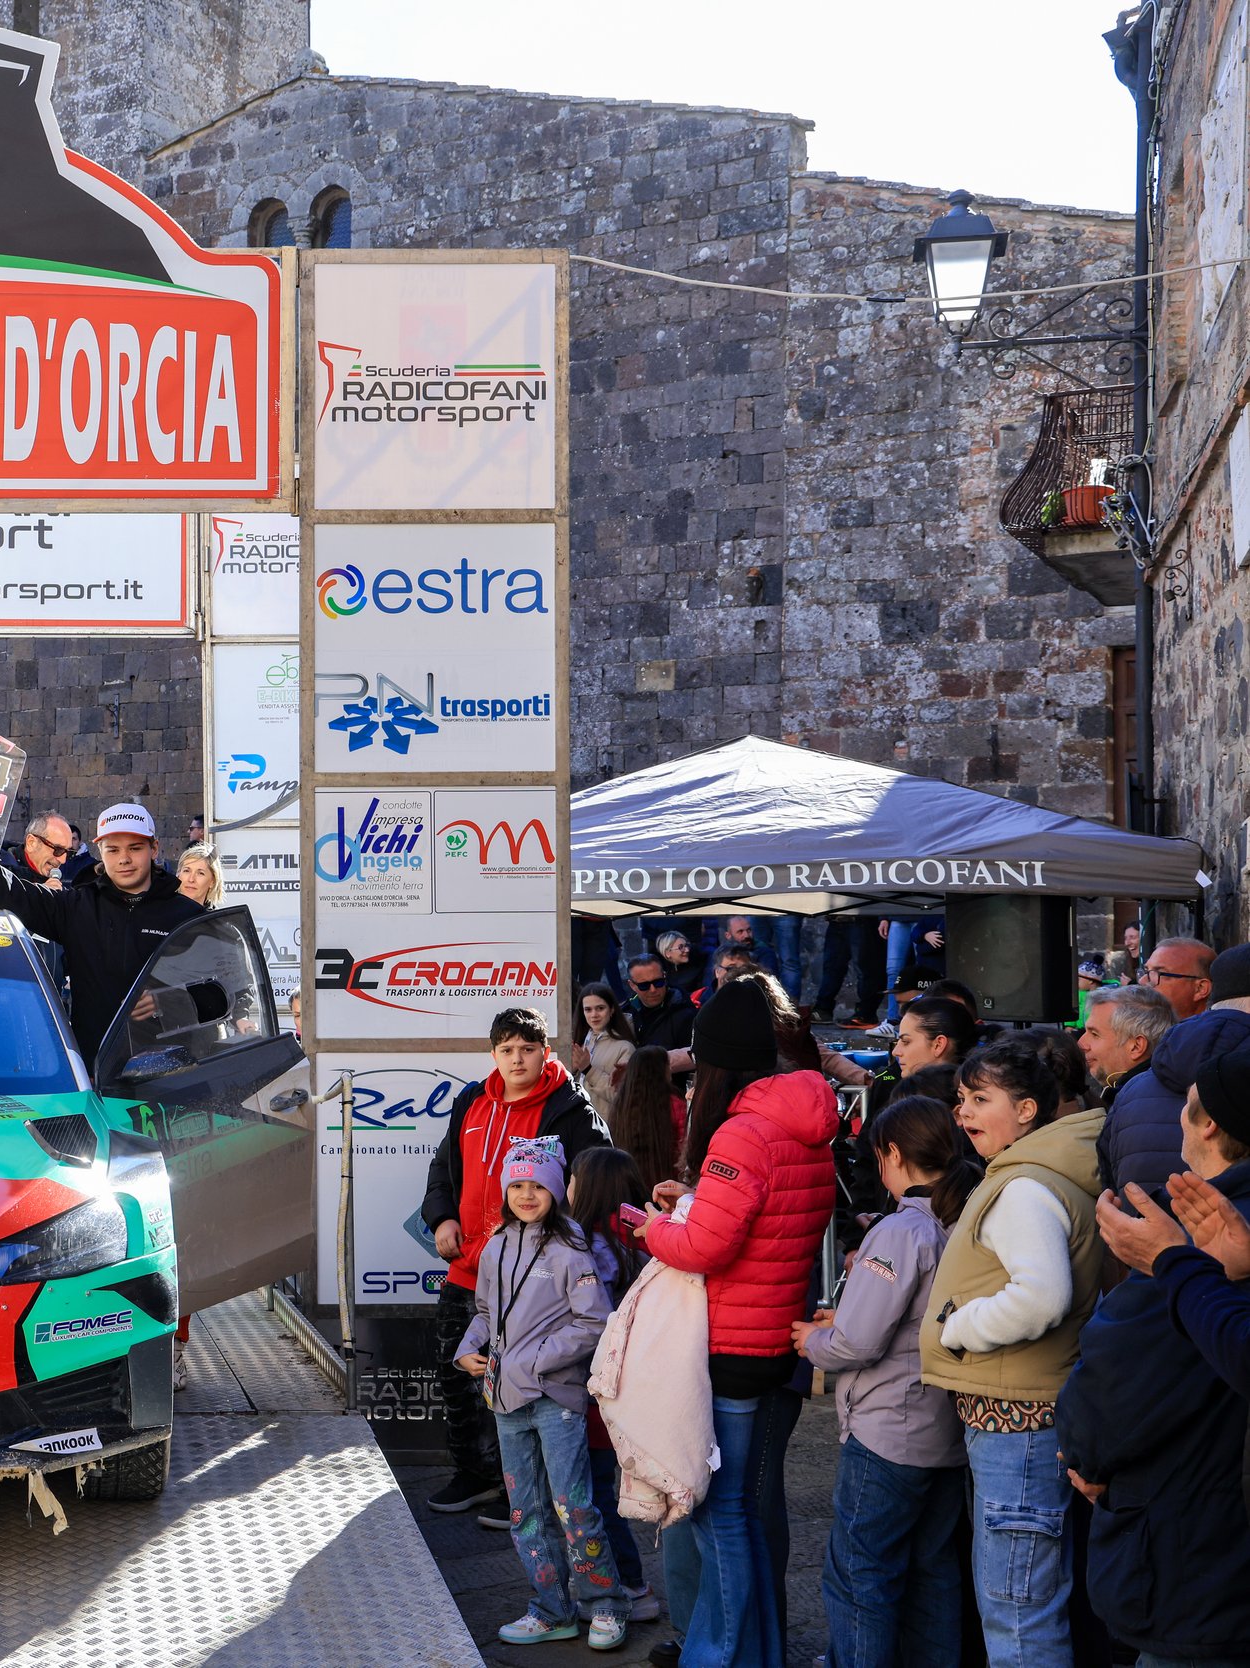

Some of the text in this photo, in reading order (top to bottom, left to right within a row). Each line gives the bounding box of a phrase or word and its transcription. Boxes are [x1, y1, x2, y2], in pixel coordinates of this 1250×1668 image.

[365, 365, 451, 377] Scuderia
[3, 315, 243, 465] D'ORCIA
[342, 381, 547, 401] RADICOFANI
[331, 402, 536, 428] motorsport
[372, 557, 549, 614] estra
[440, 694, 550, 720] trasporti
[382, 800, 422, 810] condotte
[371, 814, 423, 828] impresa
[337, 797, 424, 880] Vichi
[367, 873, 401, 882] edilizia
[403, 882, 423, 890] terra
[572, 859, 1047, 895] PRO LOCO RADICOFANI
[385, 988, 554, 997] TRASPORTI & LOGISTICA SINCE 1957
[711, 1162, 736, 1178] PYREX
[53, 1310, 132, 1335] FOMEC
[377, 1367, 438, 1378] Scuder
